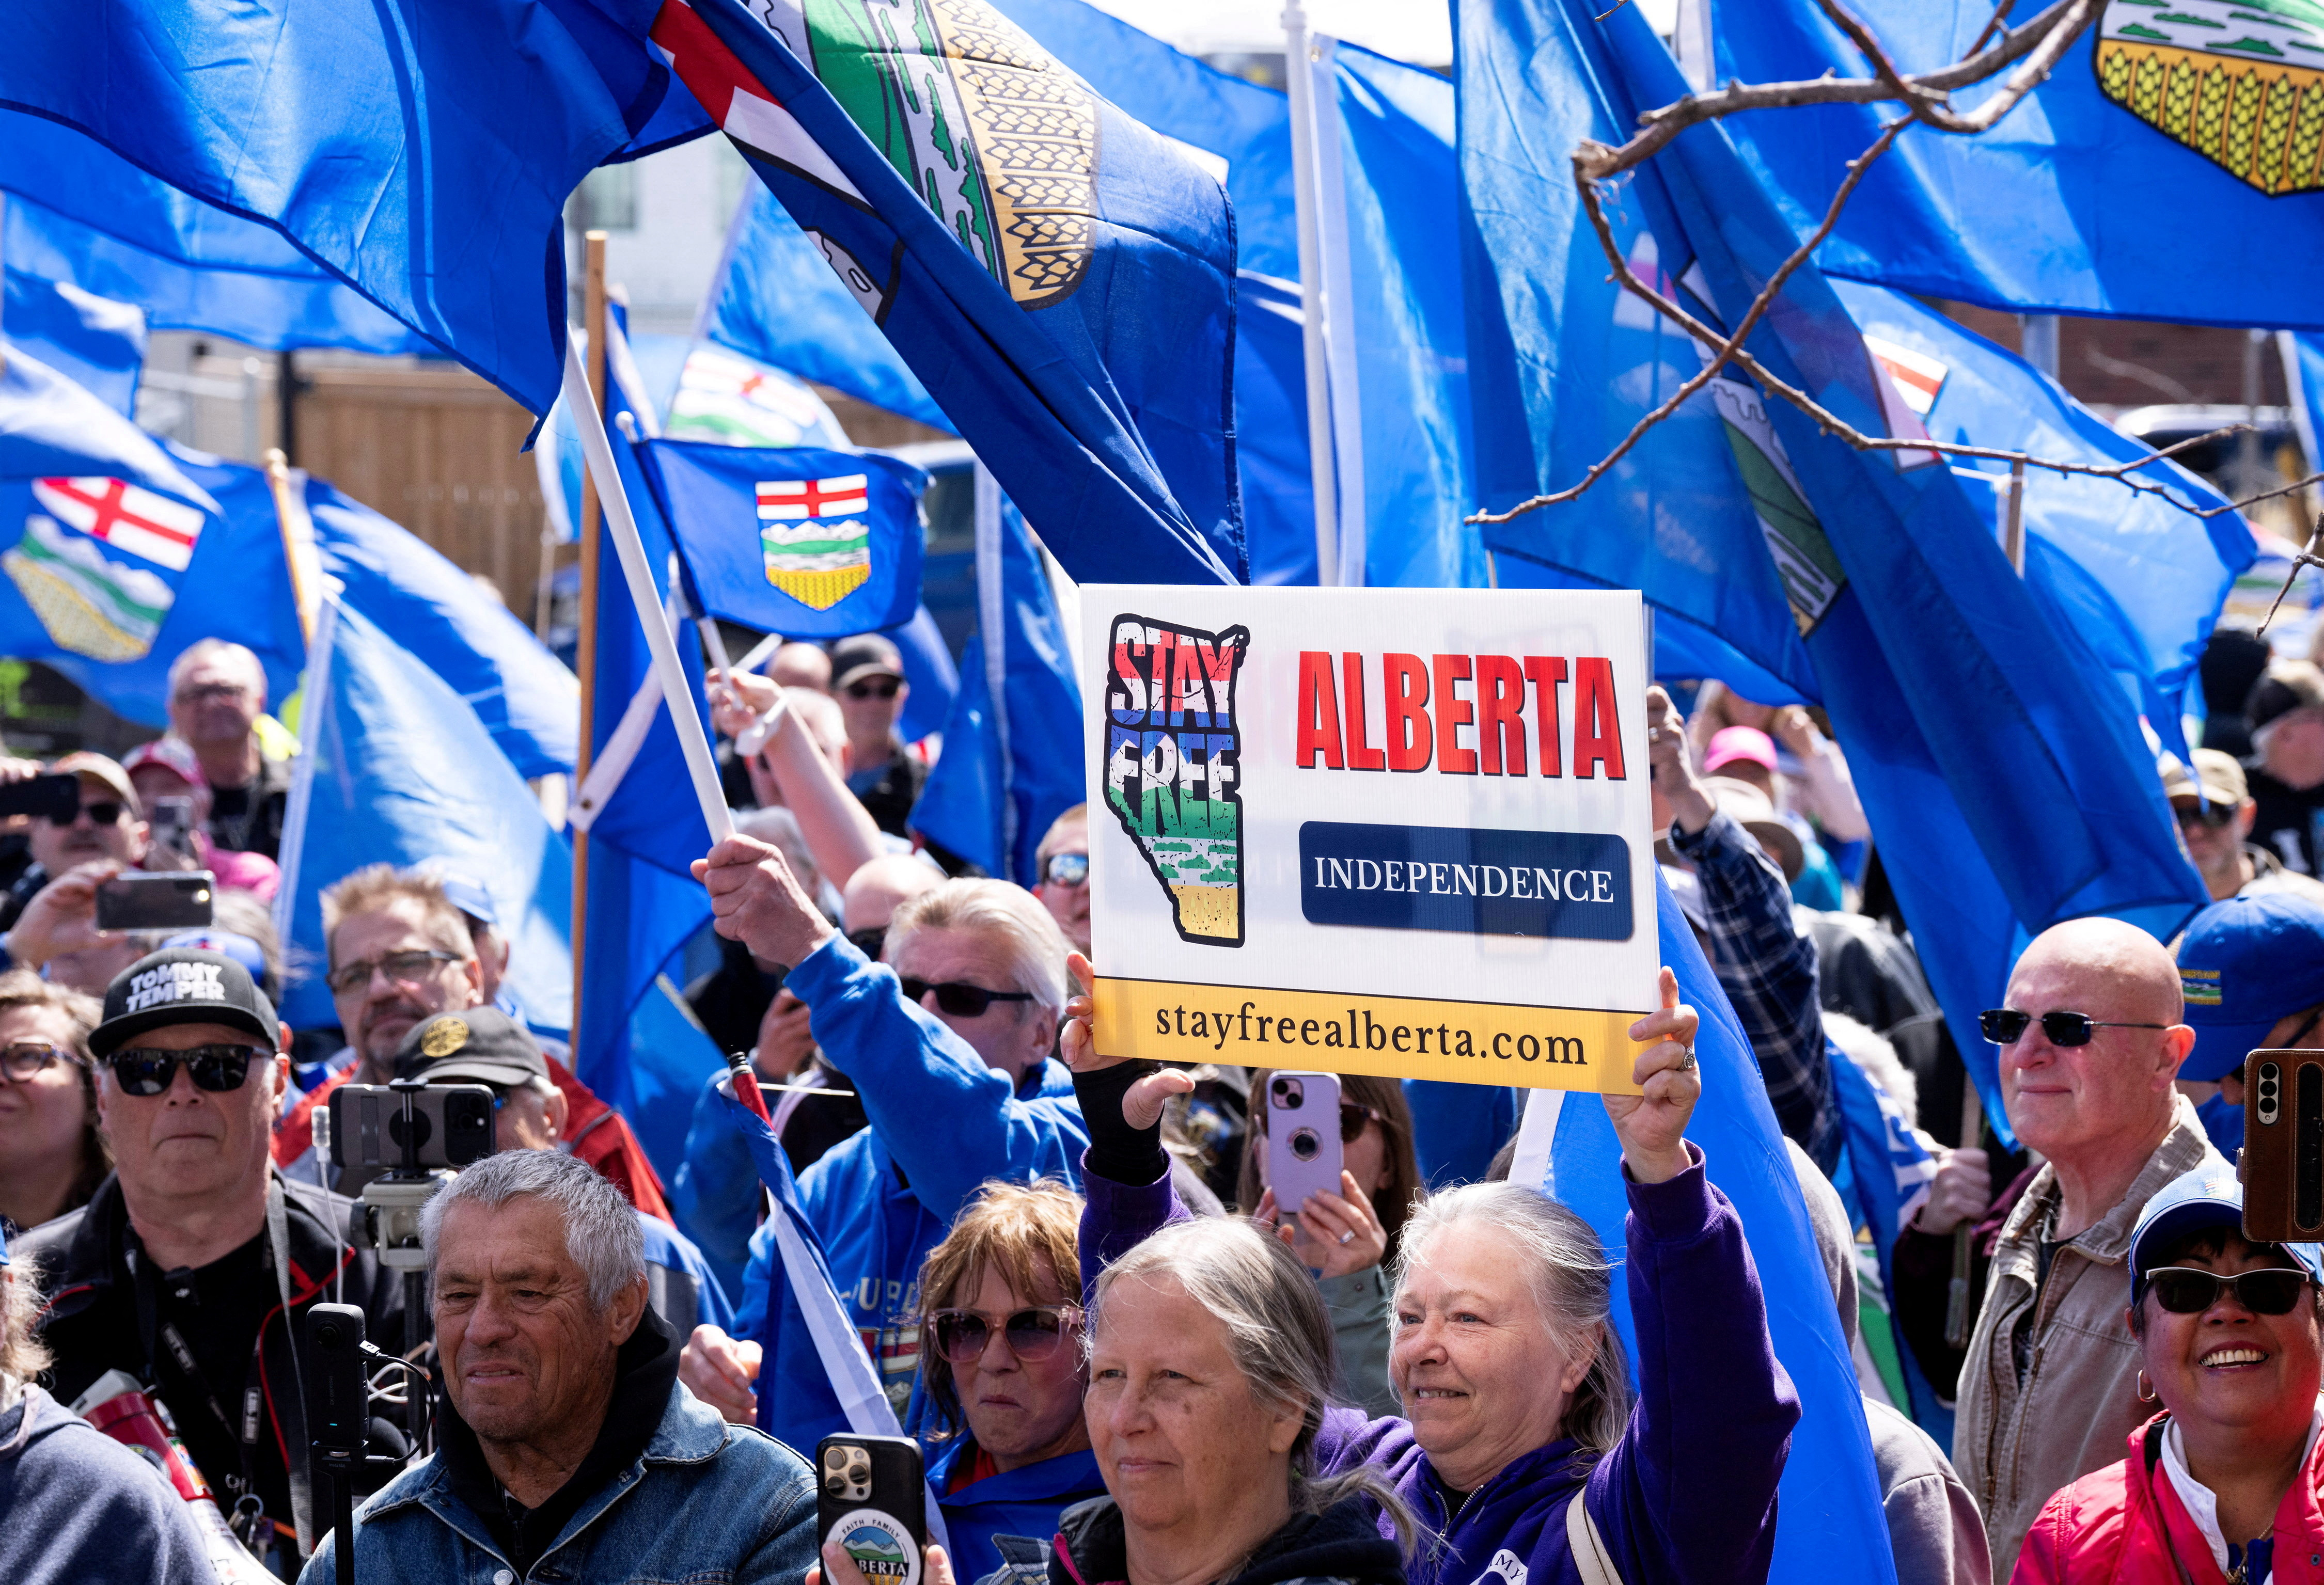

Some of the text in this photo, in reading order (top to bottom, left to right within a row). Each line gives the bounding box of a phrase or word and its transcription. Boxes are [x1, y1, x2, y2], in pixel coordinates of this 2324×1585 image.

[1110, 621, 1244, 728] STAY
[1296, 651, 1626, 781] ALBERTA
[1108, 725, 1237, 841] FREE
[1314, 857, 1613, 903] INDEPENDENCE
[126, 980, 226, 1013] TEMPER
[130, 962, 223, 995] TOMMY
[1156, 1002, 1588, 1066] stayfreealberta.com
[842, 1519, 900, 1539] FAITH FAMILY
[858, 1560, 906, 1575] BERTA
